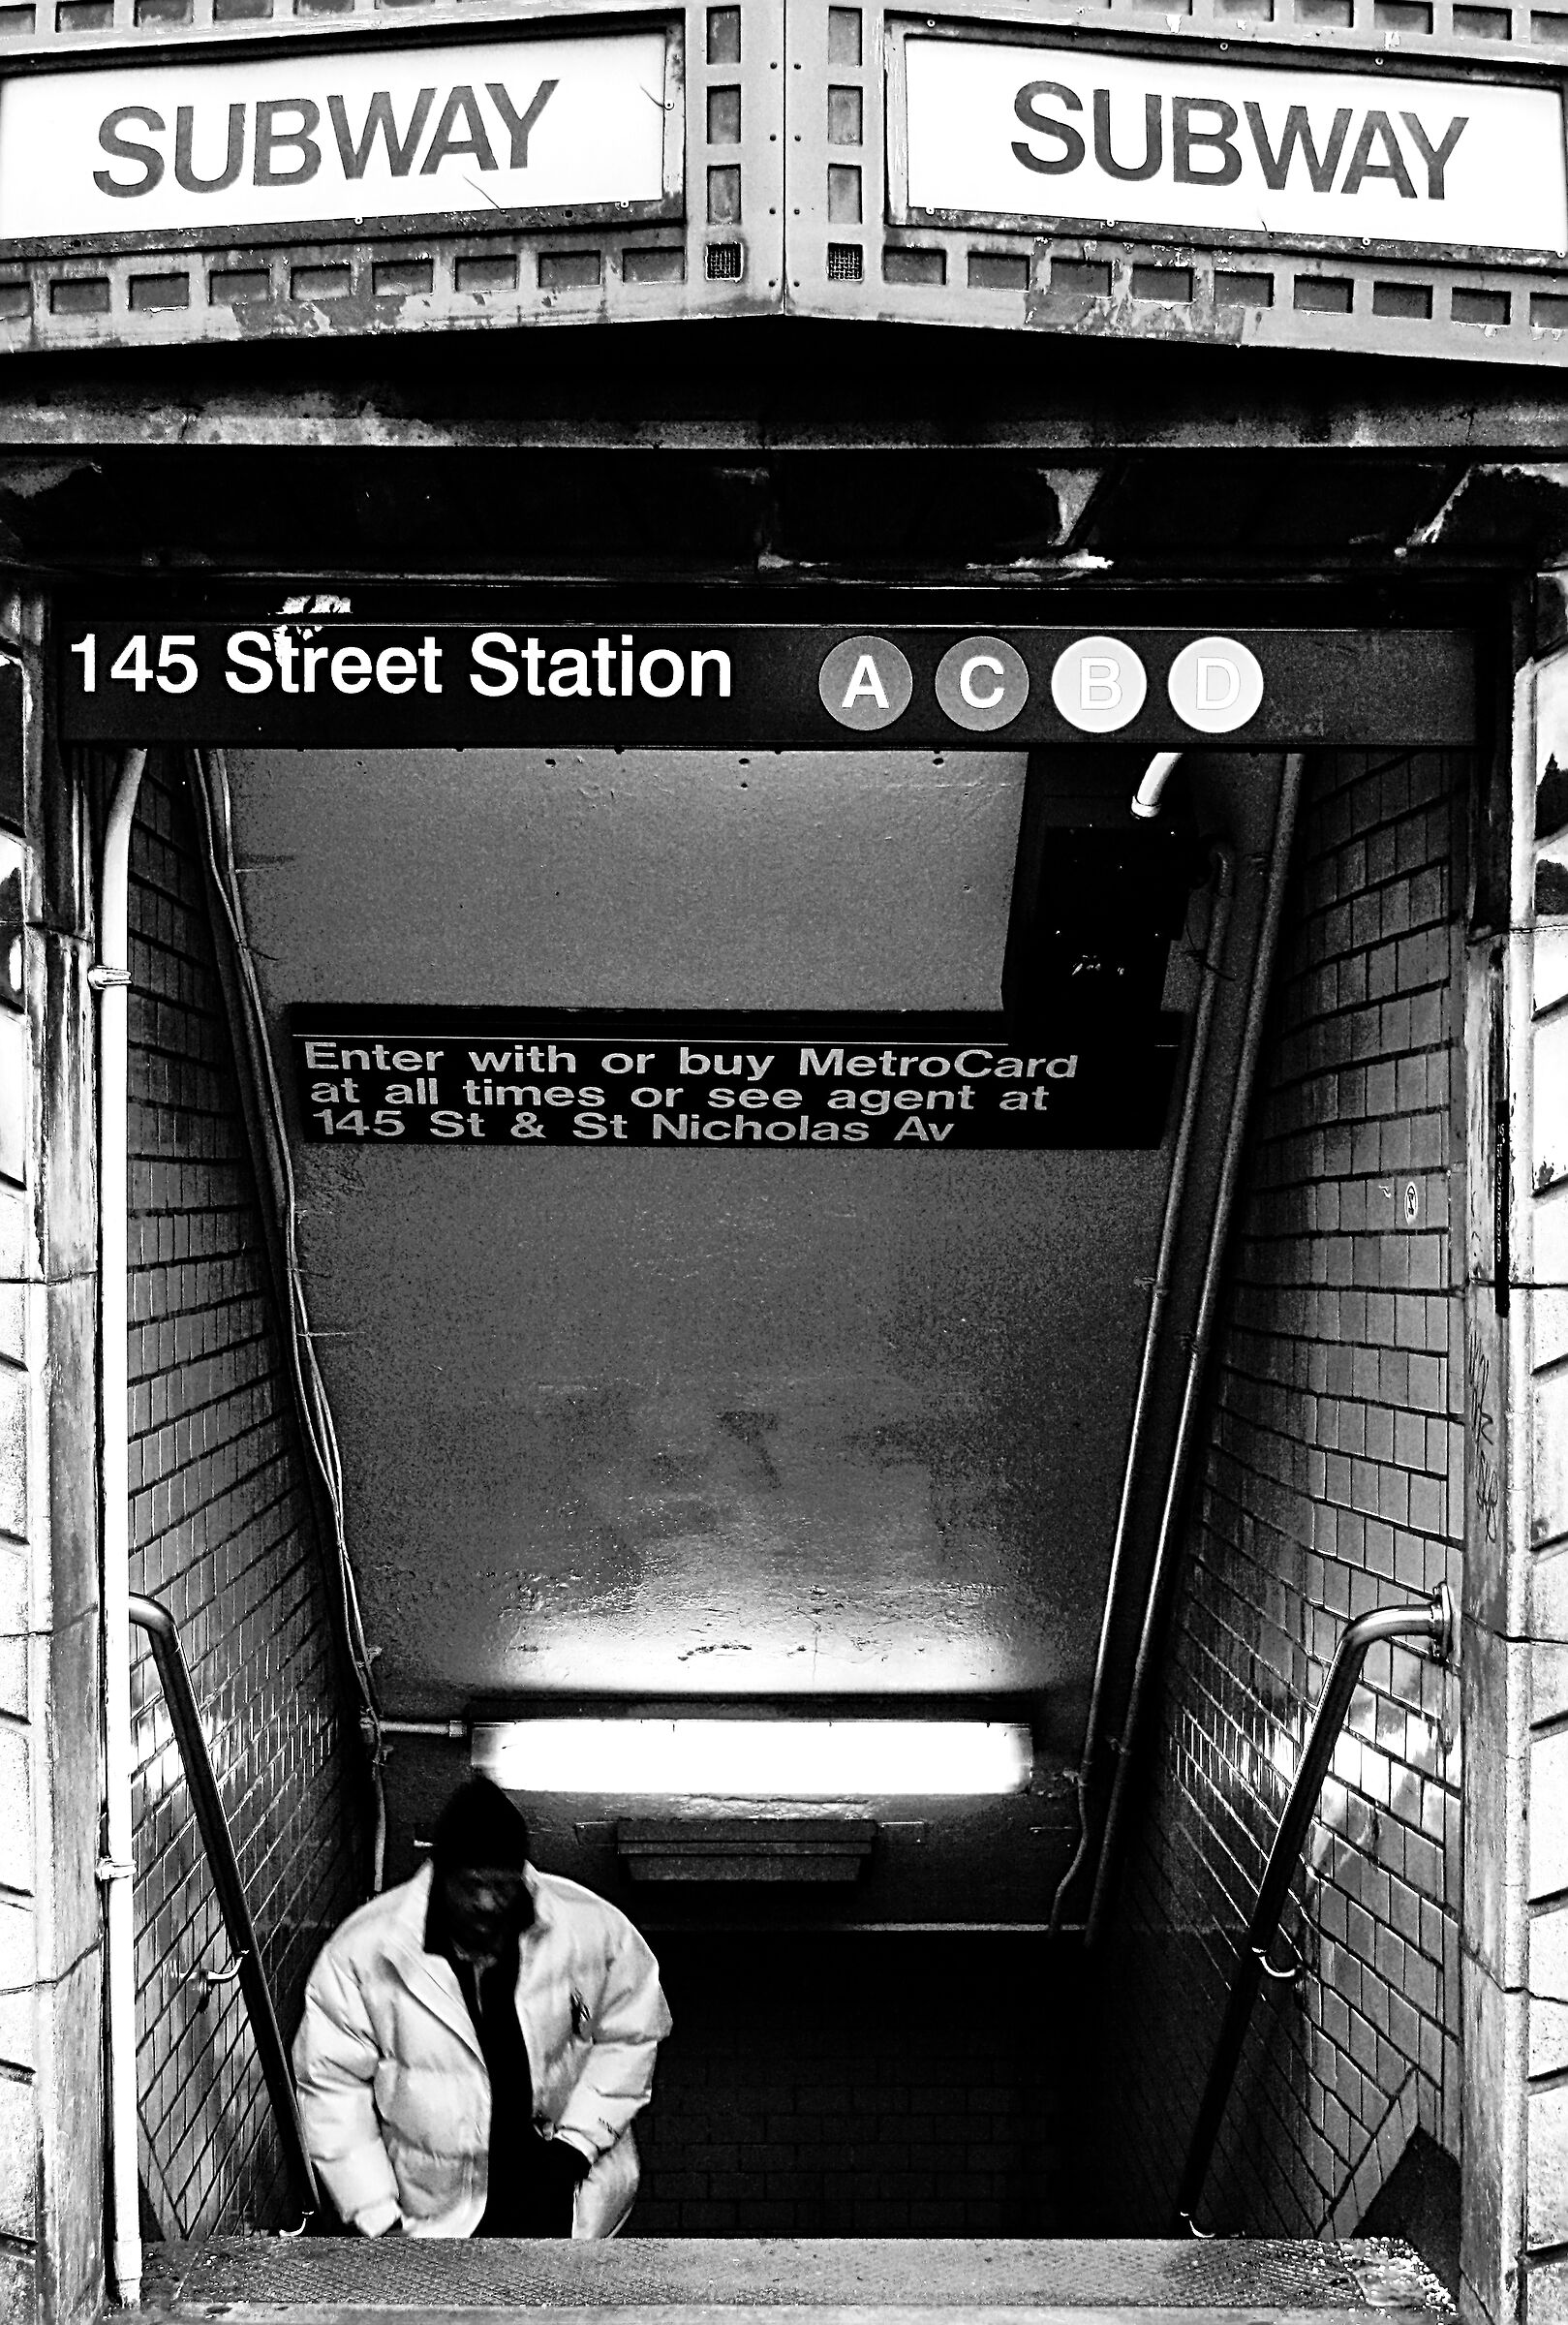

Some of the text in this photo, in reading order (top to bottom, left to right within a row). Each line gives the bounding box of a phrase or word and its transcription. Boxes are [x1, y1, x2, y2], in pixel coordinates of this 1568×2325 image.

[92, 79, 560, 199] SUBWAY
[1011, 80, 1469, 201] SUBWAY
[72, 631, 1243, 711] 145 Street Station A C B D
[305, 1042, 1078, 1080] Enter with or buy MetroCard
[311, 1078, 1049, 1115] at all times or see agent at
[313, 1109, 954, 1142] 145 St & St Nicholas Av
